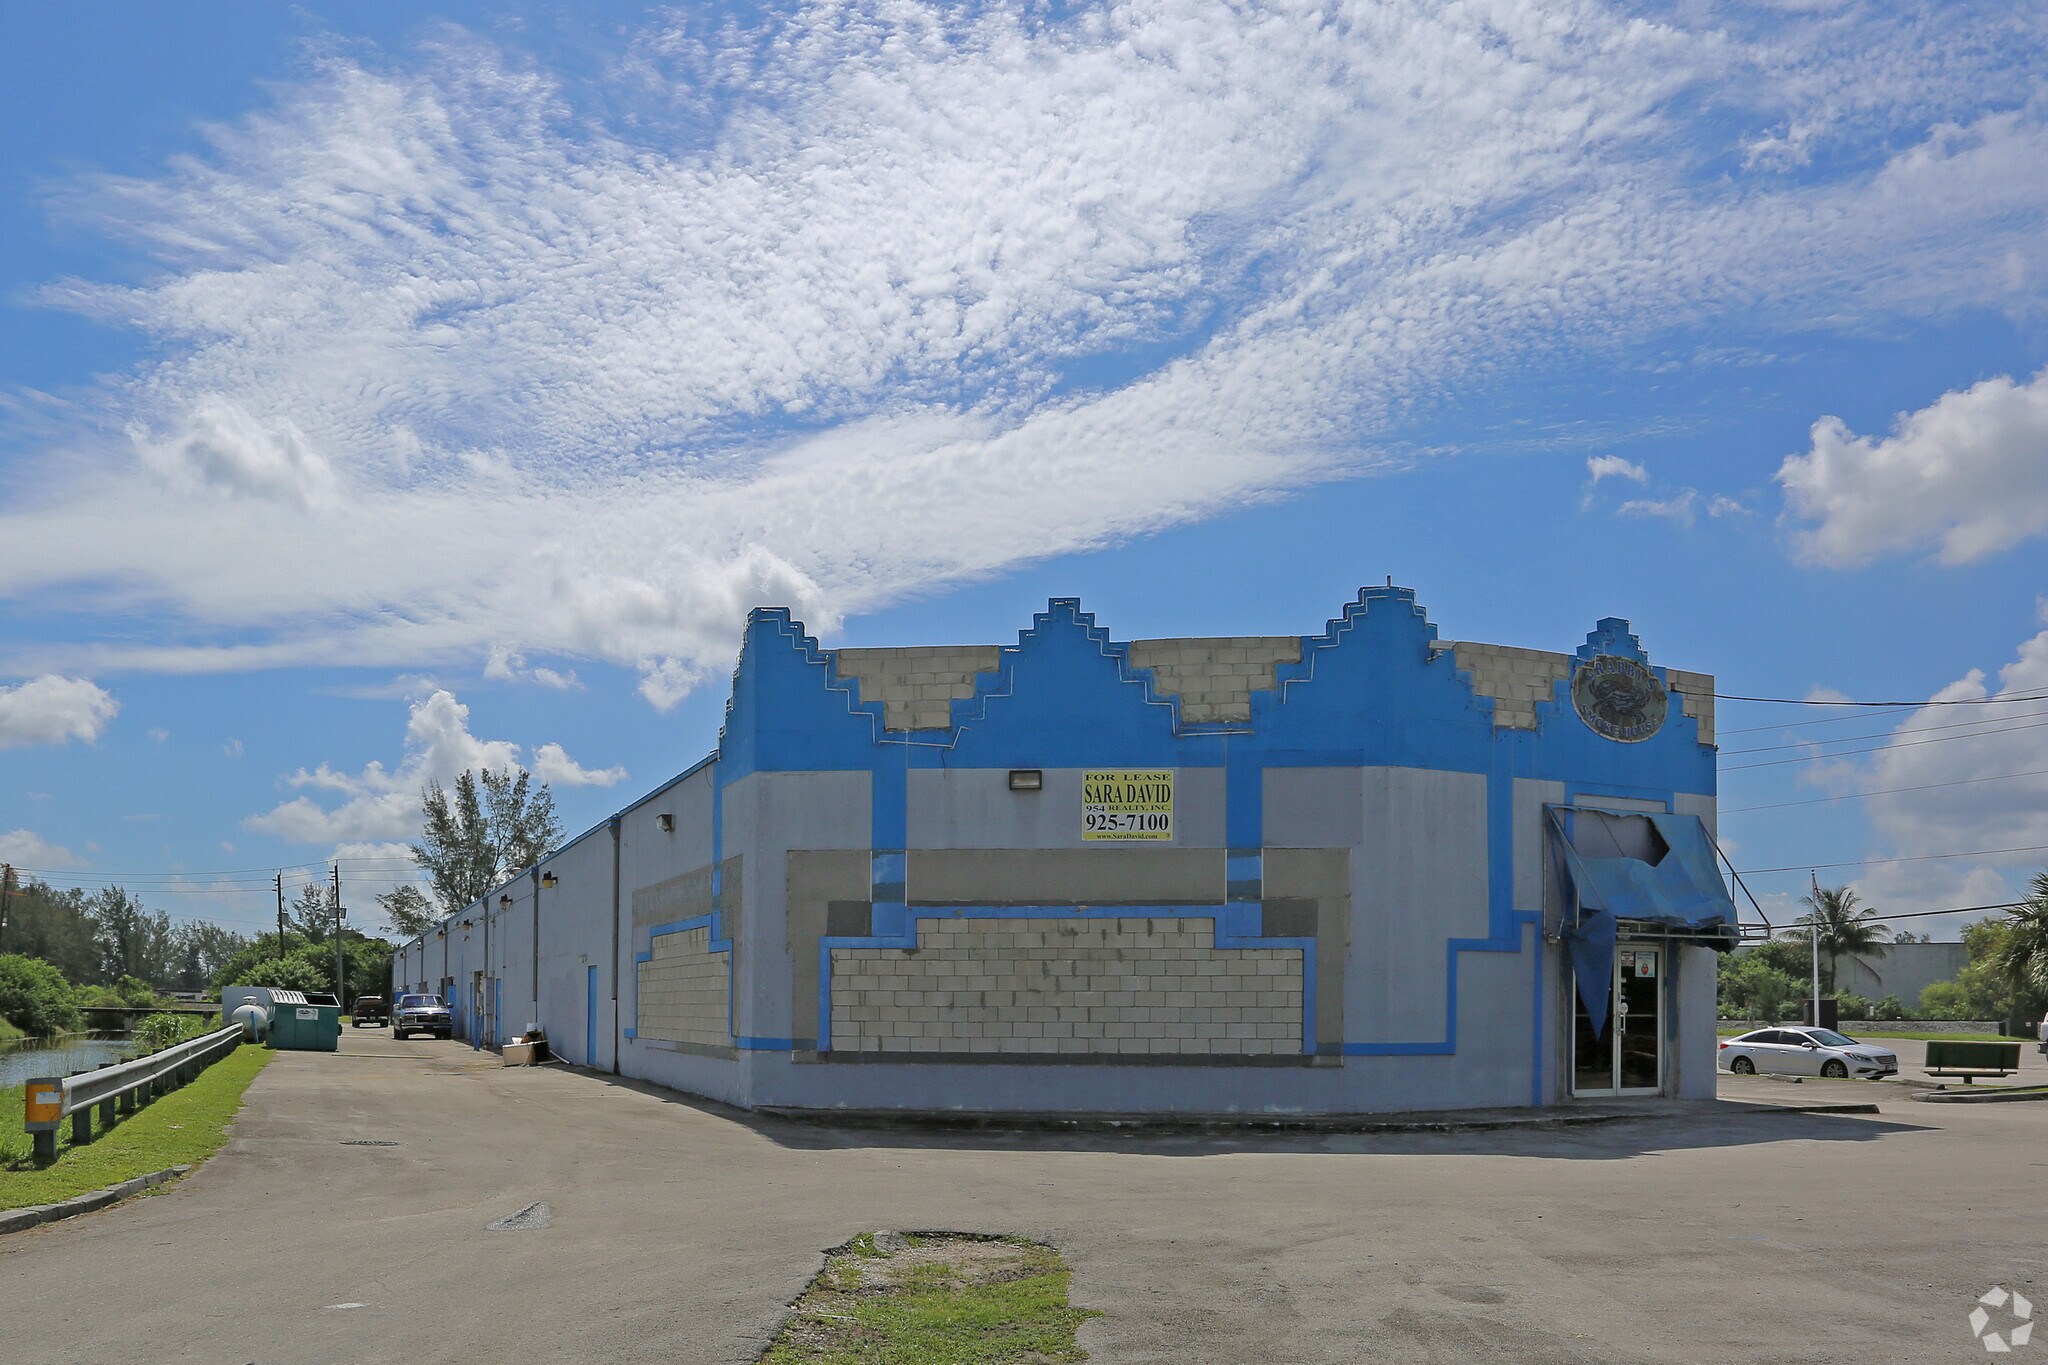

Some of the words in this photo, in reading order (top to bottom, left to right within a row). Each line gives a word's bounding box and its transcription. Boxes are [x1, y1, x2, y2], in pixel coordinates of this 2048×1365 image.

[1584, 660, 1656, 691] CRABBYS
[1581, 704, 1620, 737] SMOKE
[1623, 719, 1660, 737] HOUSE
[1084, 784, 1123, 803] SARA
[1127, 784, 1171, 803] DAVID
[1085, 814, 1169, 831] 925-7100
